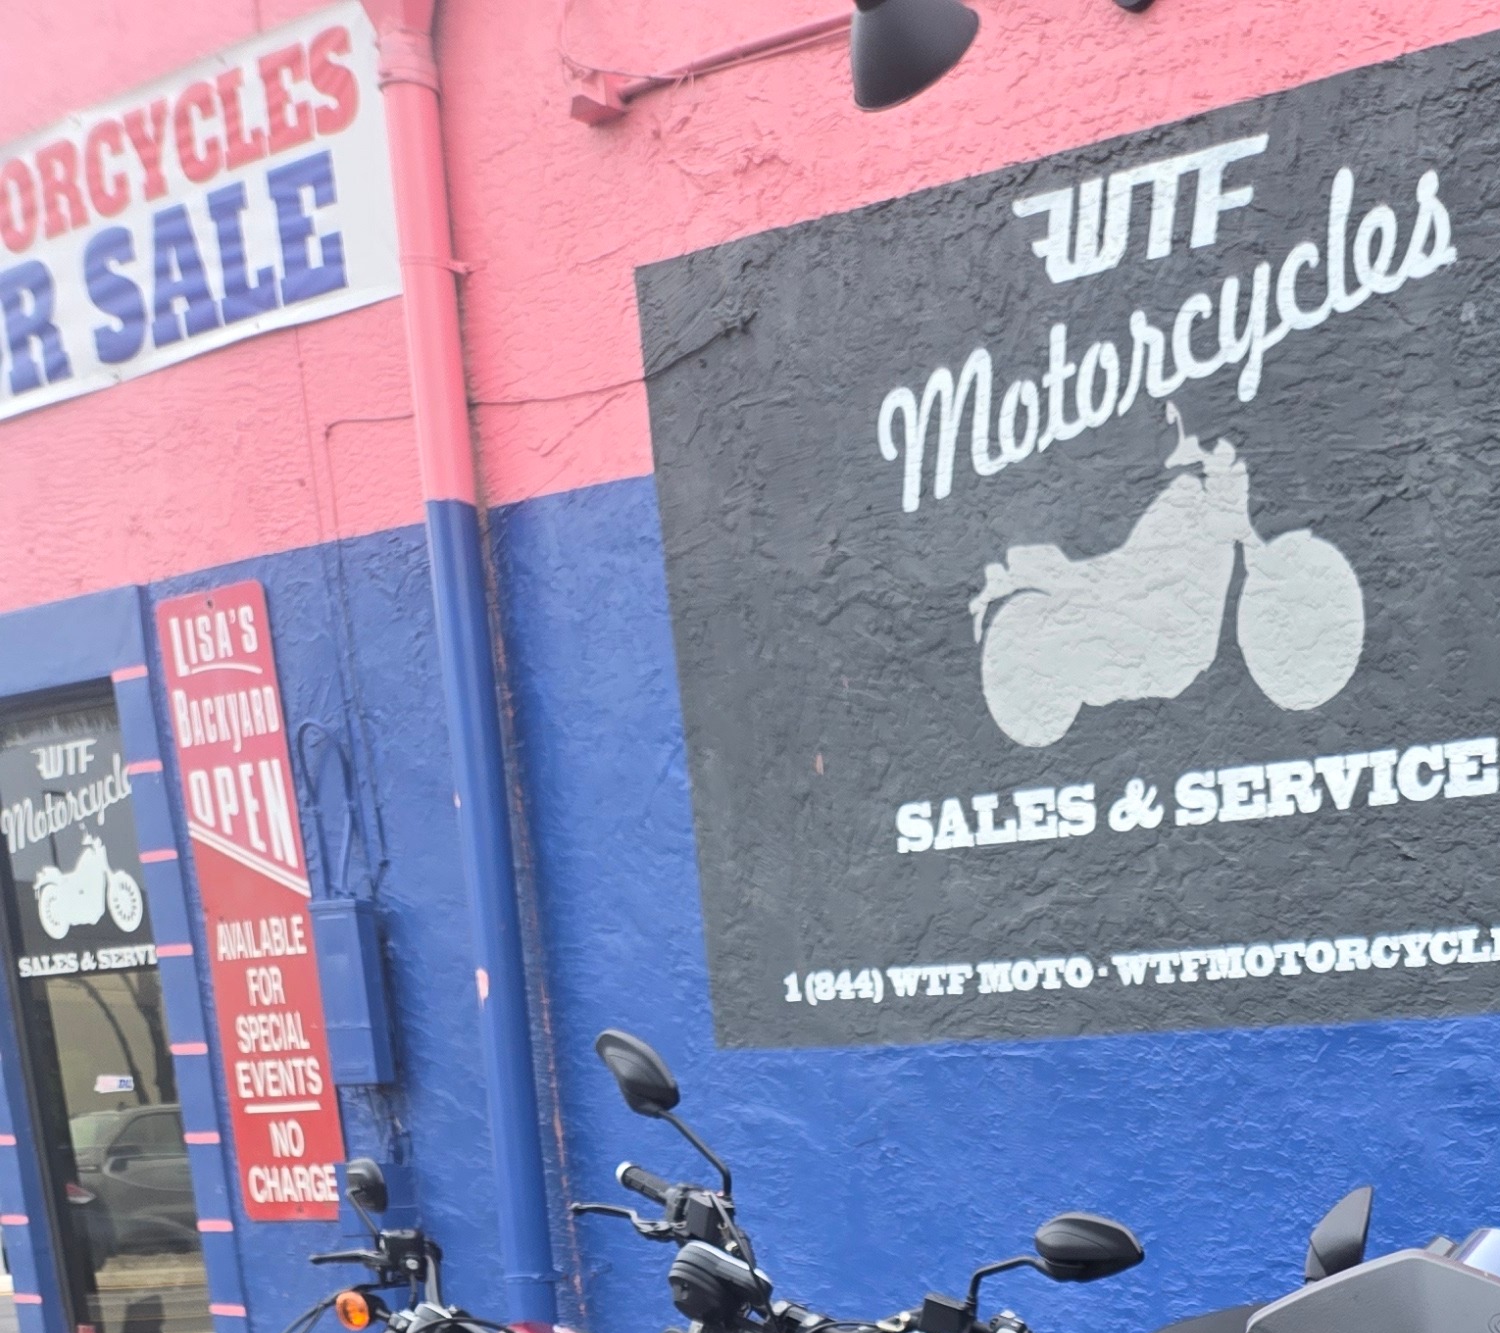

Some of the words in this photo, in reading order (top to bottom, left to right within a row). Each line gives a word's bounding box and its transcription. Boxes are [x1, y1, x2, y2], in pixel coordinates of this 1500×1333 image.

[1013, 133, 1269, 284] WTF
[84, 150, 348, 364] SALE
[877, 167, 1458, 512] Motorcycles
[30, 738, 97, 780] WTF
[188, 758, 299, 869] OPEN
[896, 780, 1097, 855] SALES
[1108, 778, 1163, 831] &
[1174, 737, 1500, 828] SERVICE
[217, 914, 307, 961] AVAILABLE
[18, 953, 79, 977] SALES
[246, 965, 285, 1006] FOR
[886, 963, 974, 998] WTF
[976, 957, 1095, 994] MOTO
[235, 1011, 310, 1053] SPECIAL
[235, 1056, 323, 1098] EVENTS
[269, 1118, 305, 1157] NO
[248, 1163, 339, 1203] CHARGE
